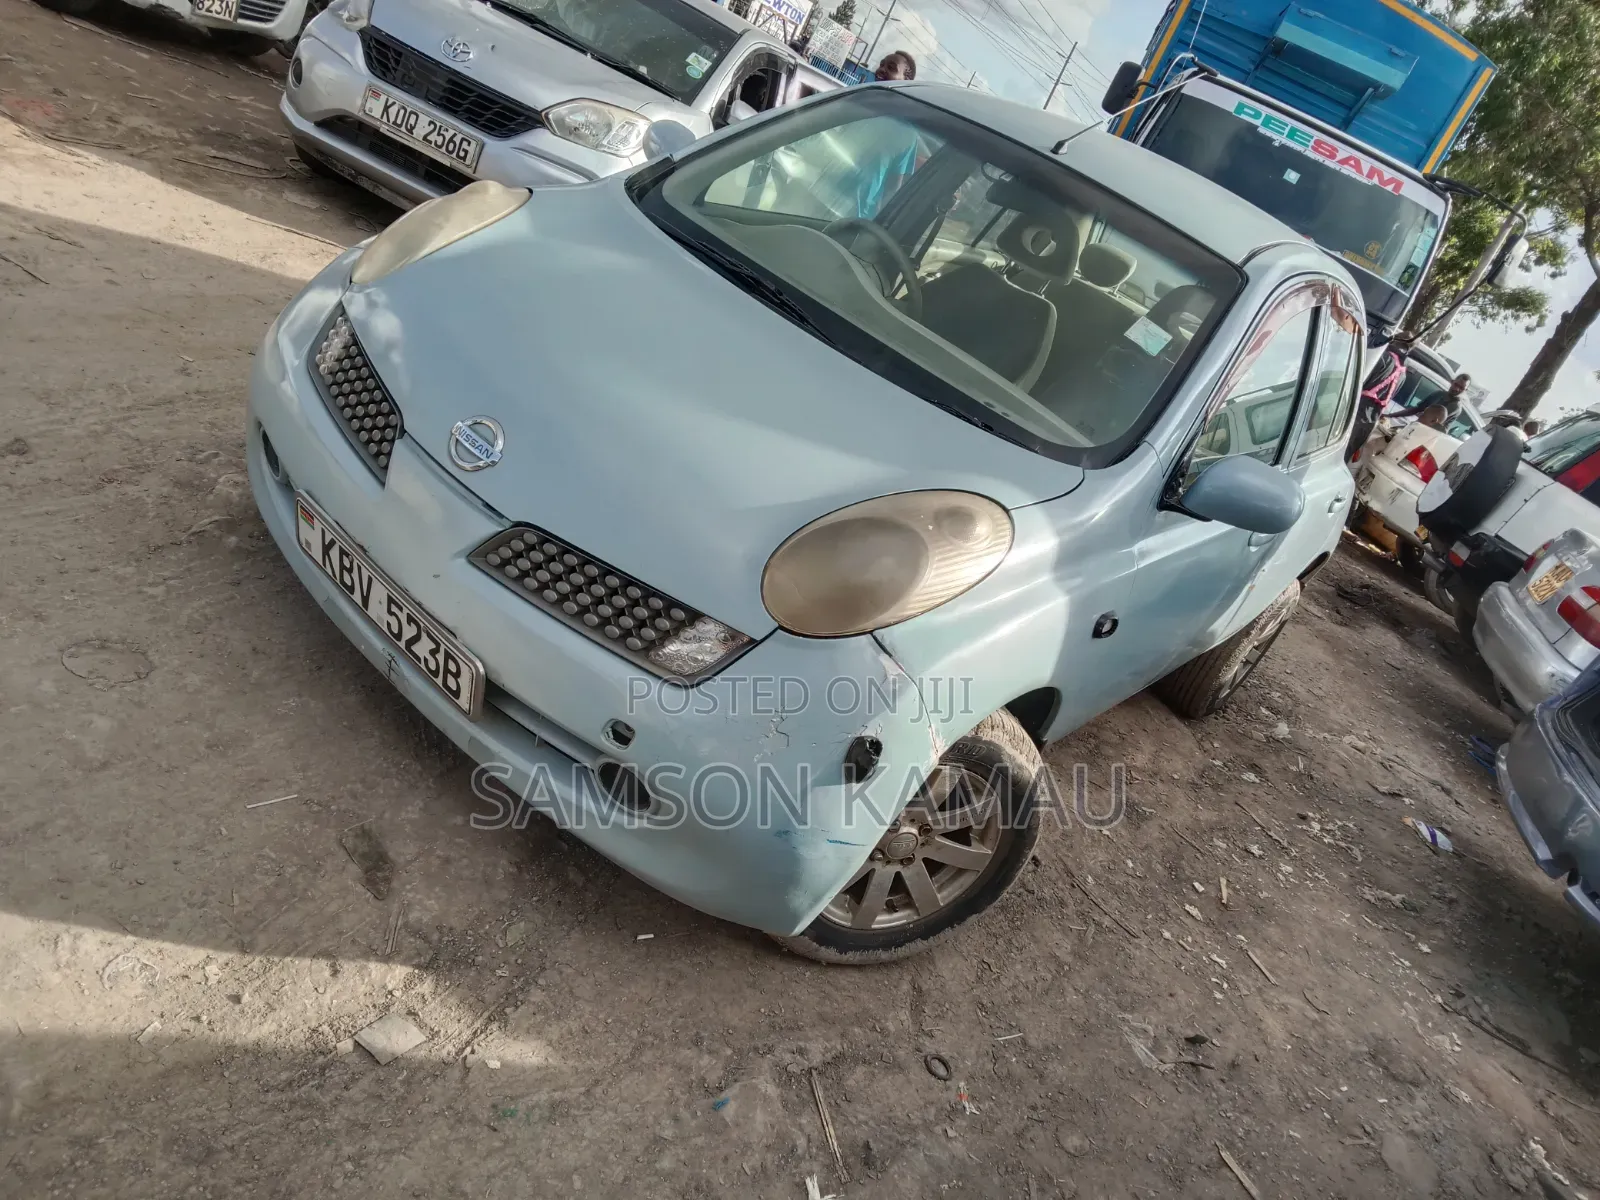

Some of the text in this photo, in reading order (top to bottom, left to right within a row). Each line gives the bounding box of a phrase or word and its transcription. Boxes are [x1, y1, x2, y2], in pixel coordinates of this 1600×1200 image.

[380, 97, 472, 163] KDQ 256G
[1232, 100, 1405, 195] PEESAM
[454, 423, 494, 460] NISSAN
[320, 526, 463, 701] KBV 523B
